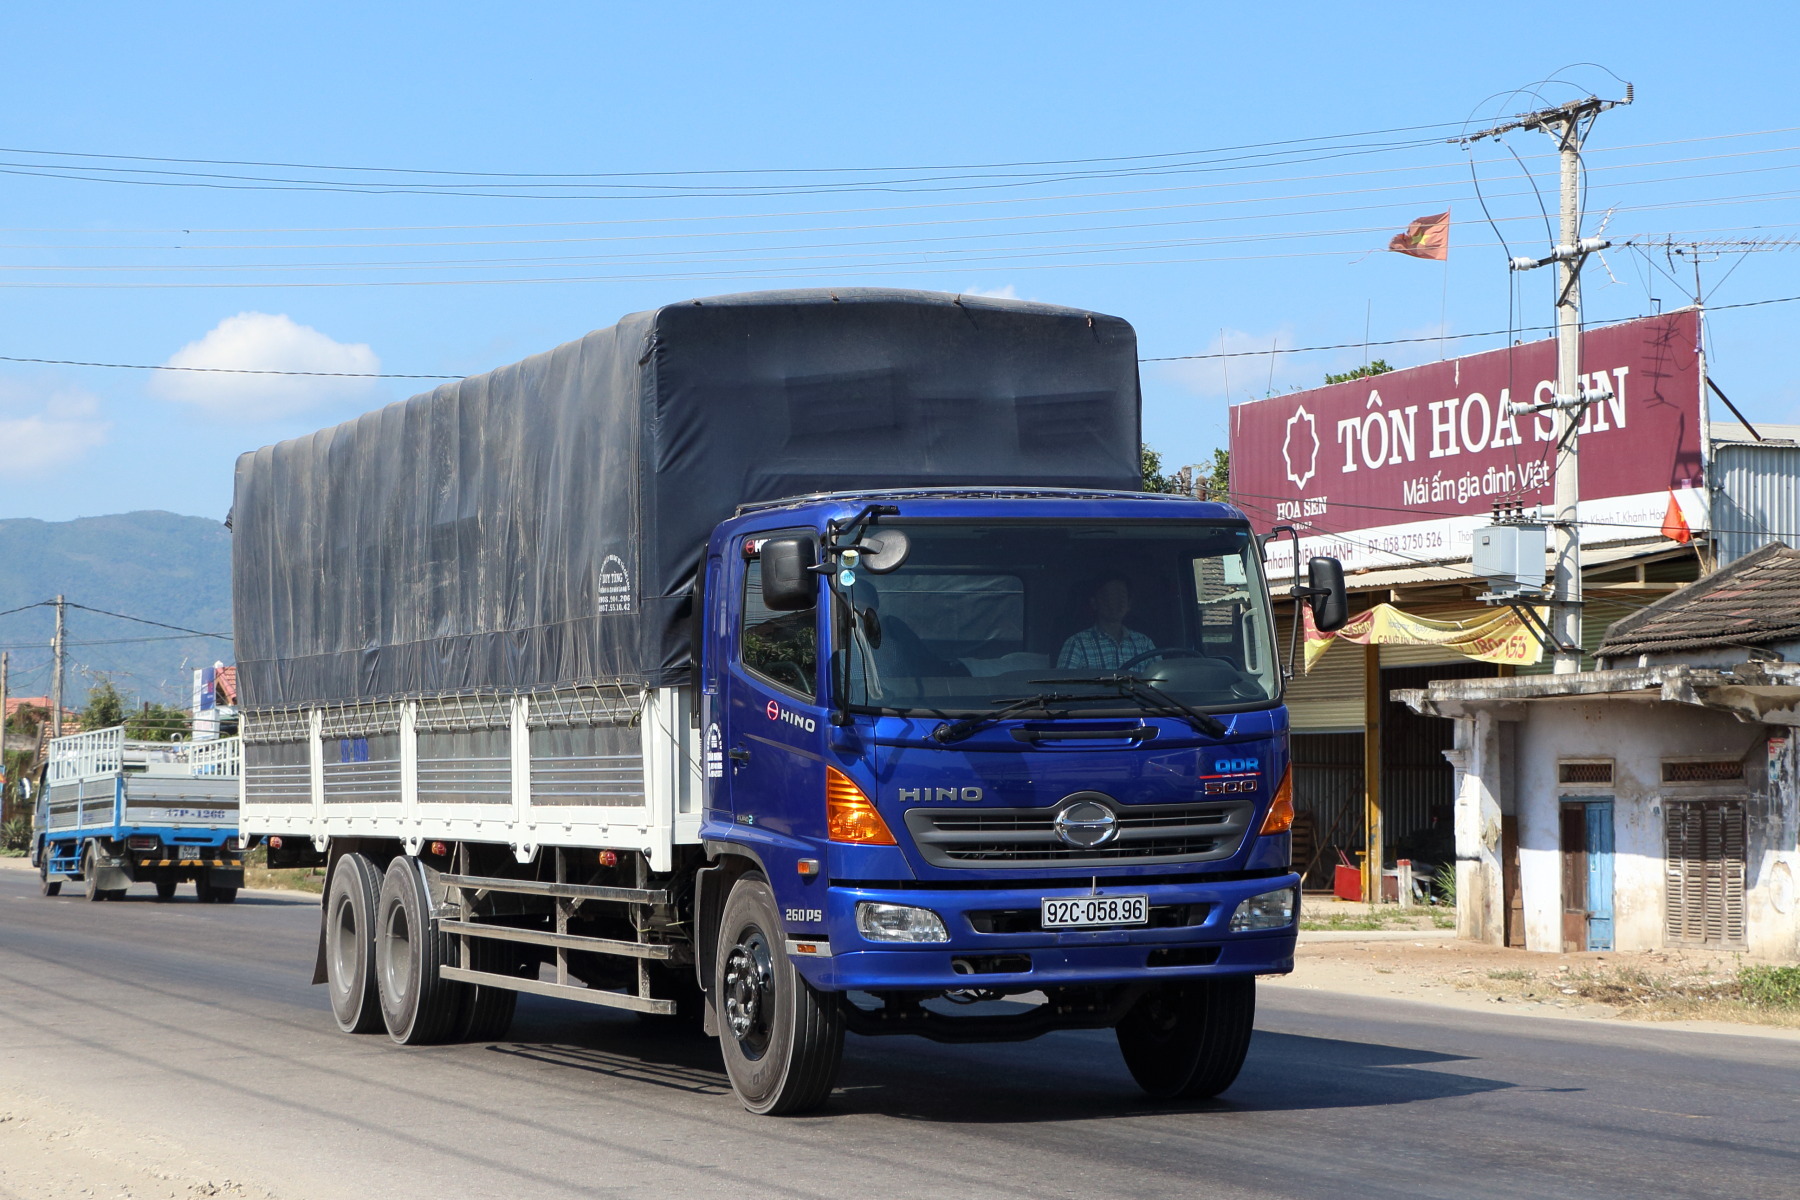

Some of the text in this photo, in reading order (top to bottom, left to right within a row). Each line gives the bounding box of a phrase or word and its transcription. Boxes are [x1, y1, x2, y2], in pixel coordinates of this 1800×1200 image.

[1338, 390, 1418, 473] TÔN
[1428, 388, 1522, 458] HOA
[1403, 459, 1550, 506] Mái ấm gia đình Việt
[1276, 496, 1328, 521] HOA SEN
[1384, 536, 1399, 553] 058
[1402, 533, 1423, 551] 3750
[1426, 531, 1442, 548] 526
[1267, 549, 1294, 570] nhánh
[1319, 540, 1353, 561] KHÁNH
[780, 709, 816, 733] HINO
[1215, 757, 1260, 774] QDR
[899, 787, 984, 802] HINO
[1204, 779, 1258, 796] 500
[1046, 899, 1144, 925] 92C-058.96
